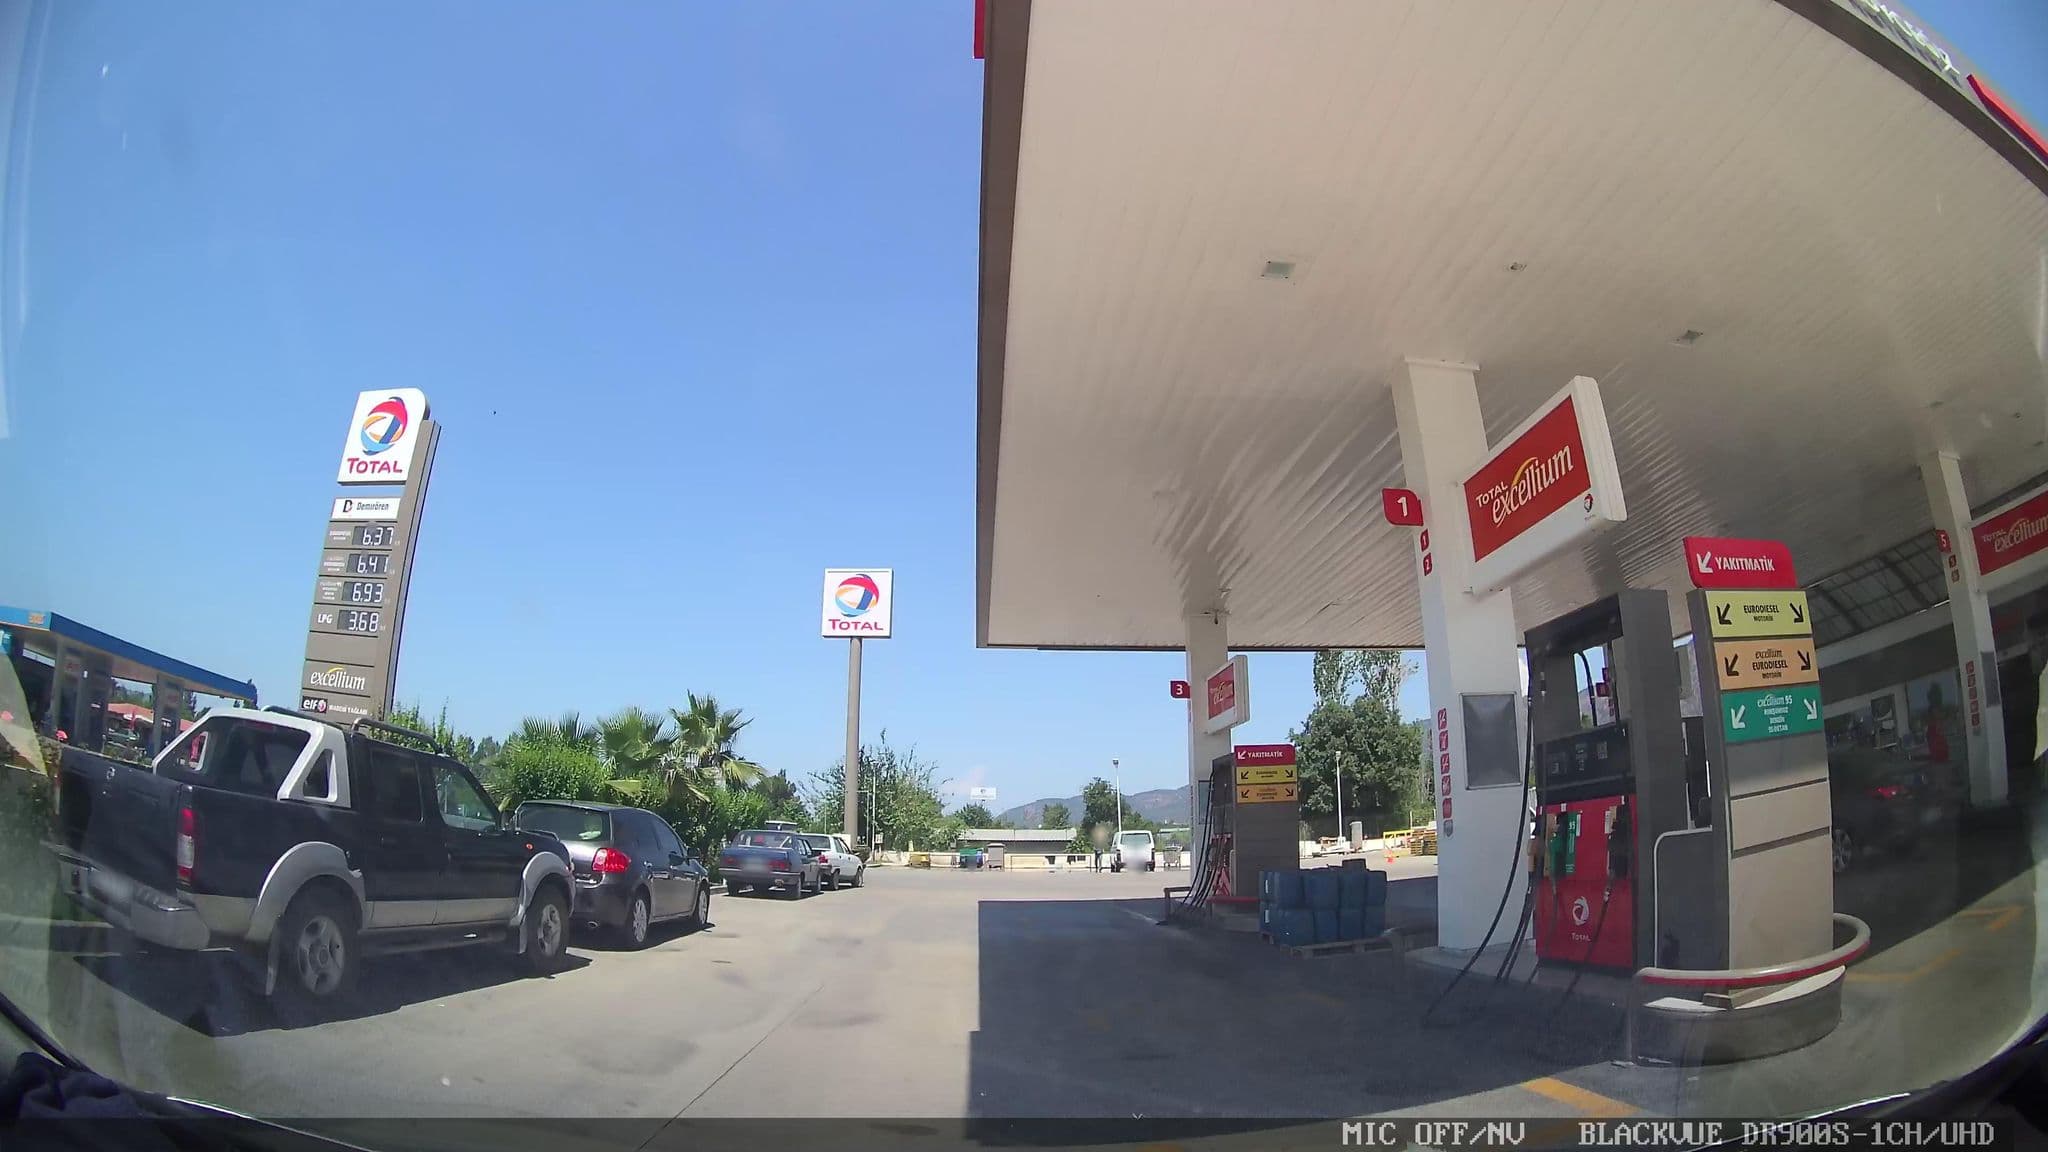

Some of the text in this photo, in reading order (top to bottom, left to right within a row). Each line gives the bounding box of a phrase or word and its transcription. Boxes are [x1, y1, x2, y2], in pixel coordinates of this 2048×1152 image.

[347, 458, 403, 474] TOTAL
[1492, 445, 1574, 527] excellium
[1475, 481, 1508, 508] TOTAL
[356, 502, 389, 511] Demirören
[1397, 496, 1408, 517] 1
[1715, 555, 1776, 572] YAKITMATİK
[1743, 604, 1780, 614] EURODIESEL
[317, 613, 334, 624] LPG
[828, 618, 884, 631] TOTAL
[1752, 660, 1789, 671] EURODIESEL
[310, 670, 366, 690] excellium
[1175, 684, 1184, 696] 3
[303, 699, 319, 710] elf
